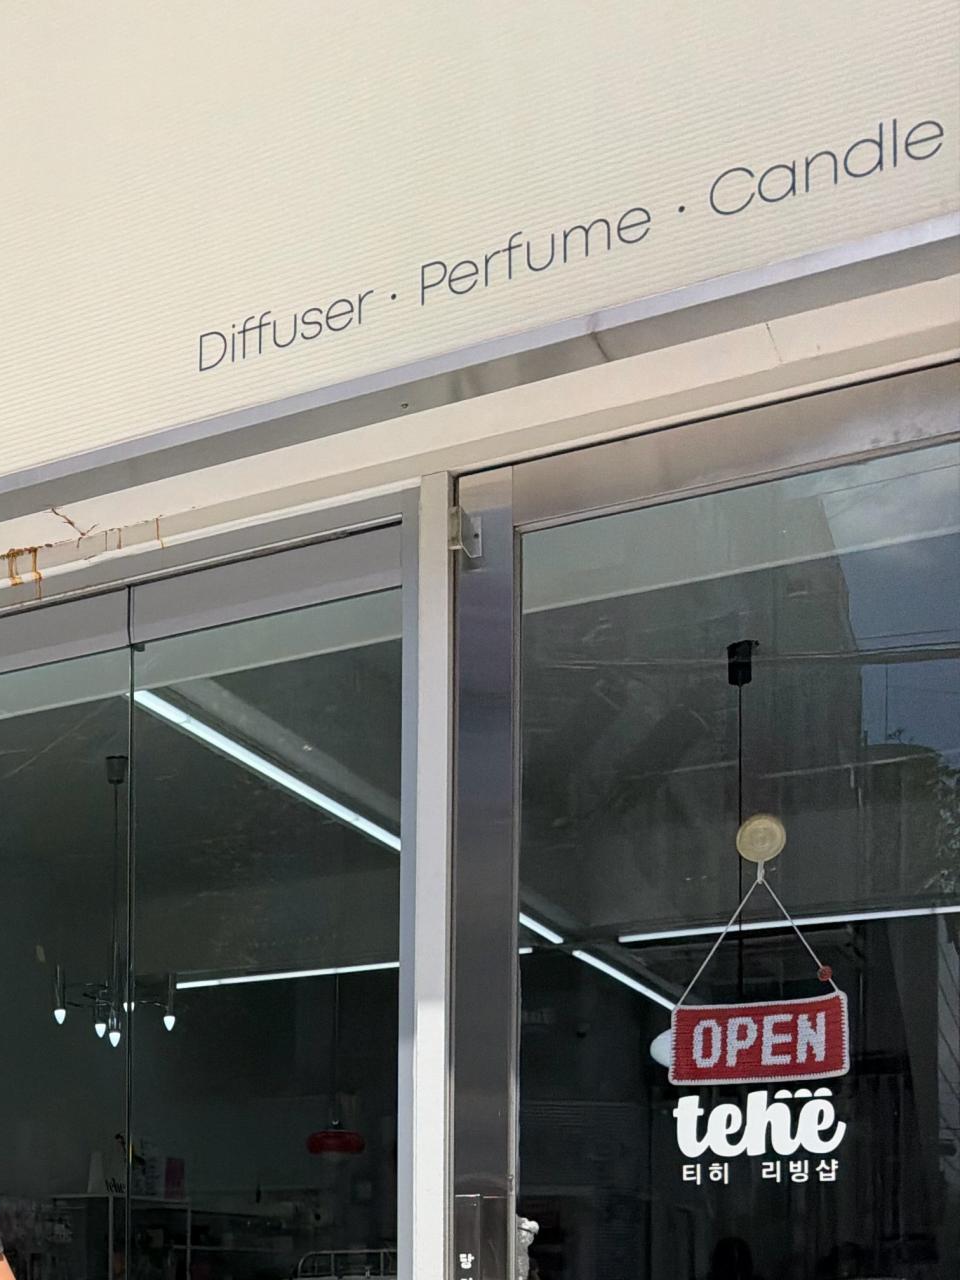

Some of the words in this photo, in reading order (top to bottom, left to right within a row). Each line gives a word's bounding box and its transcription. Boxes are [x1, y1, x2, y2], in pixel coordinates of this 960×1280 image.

[198, 289, 374, 372] Diffuser
[420, 206, 652, 305] Perfume
[709, 118, 945, 216] Candle
[691, 1011, 827, 1069] OPEN
[672, 1087, 847, 1158] tehe
[682, 1162, 729, 1185] 티히
[761, 1158, 839, 1183] 리빙샵
